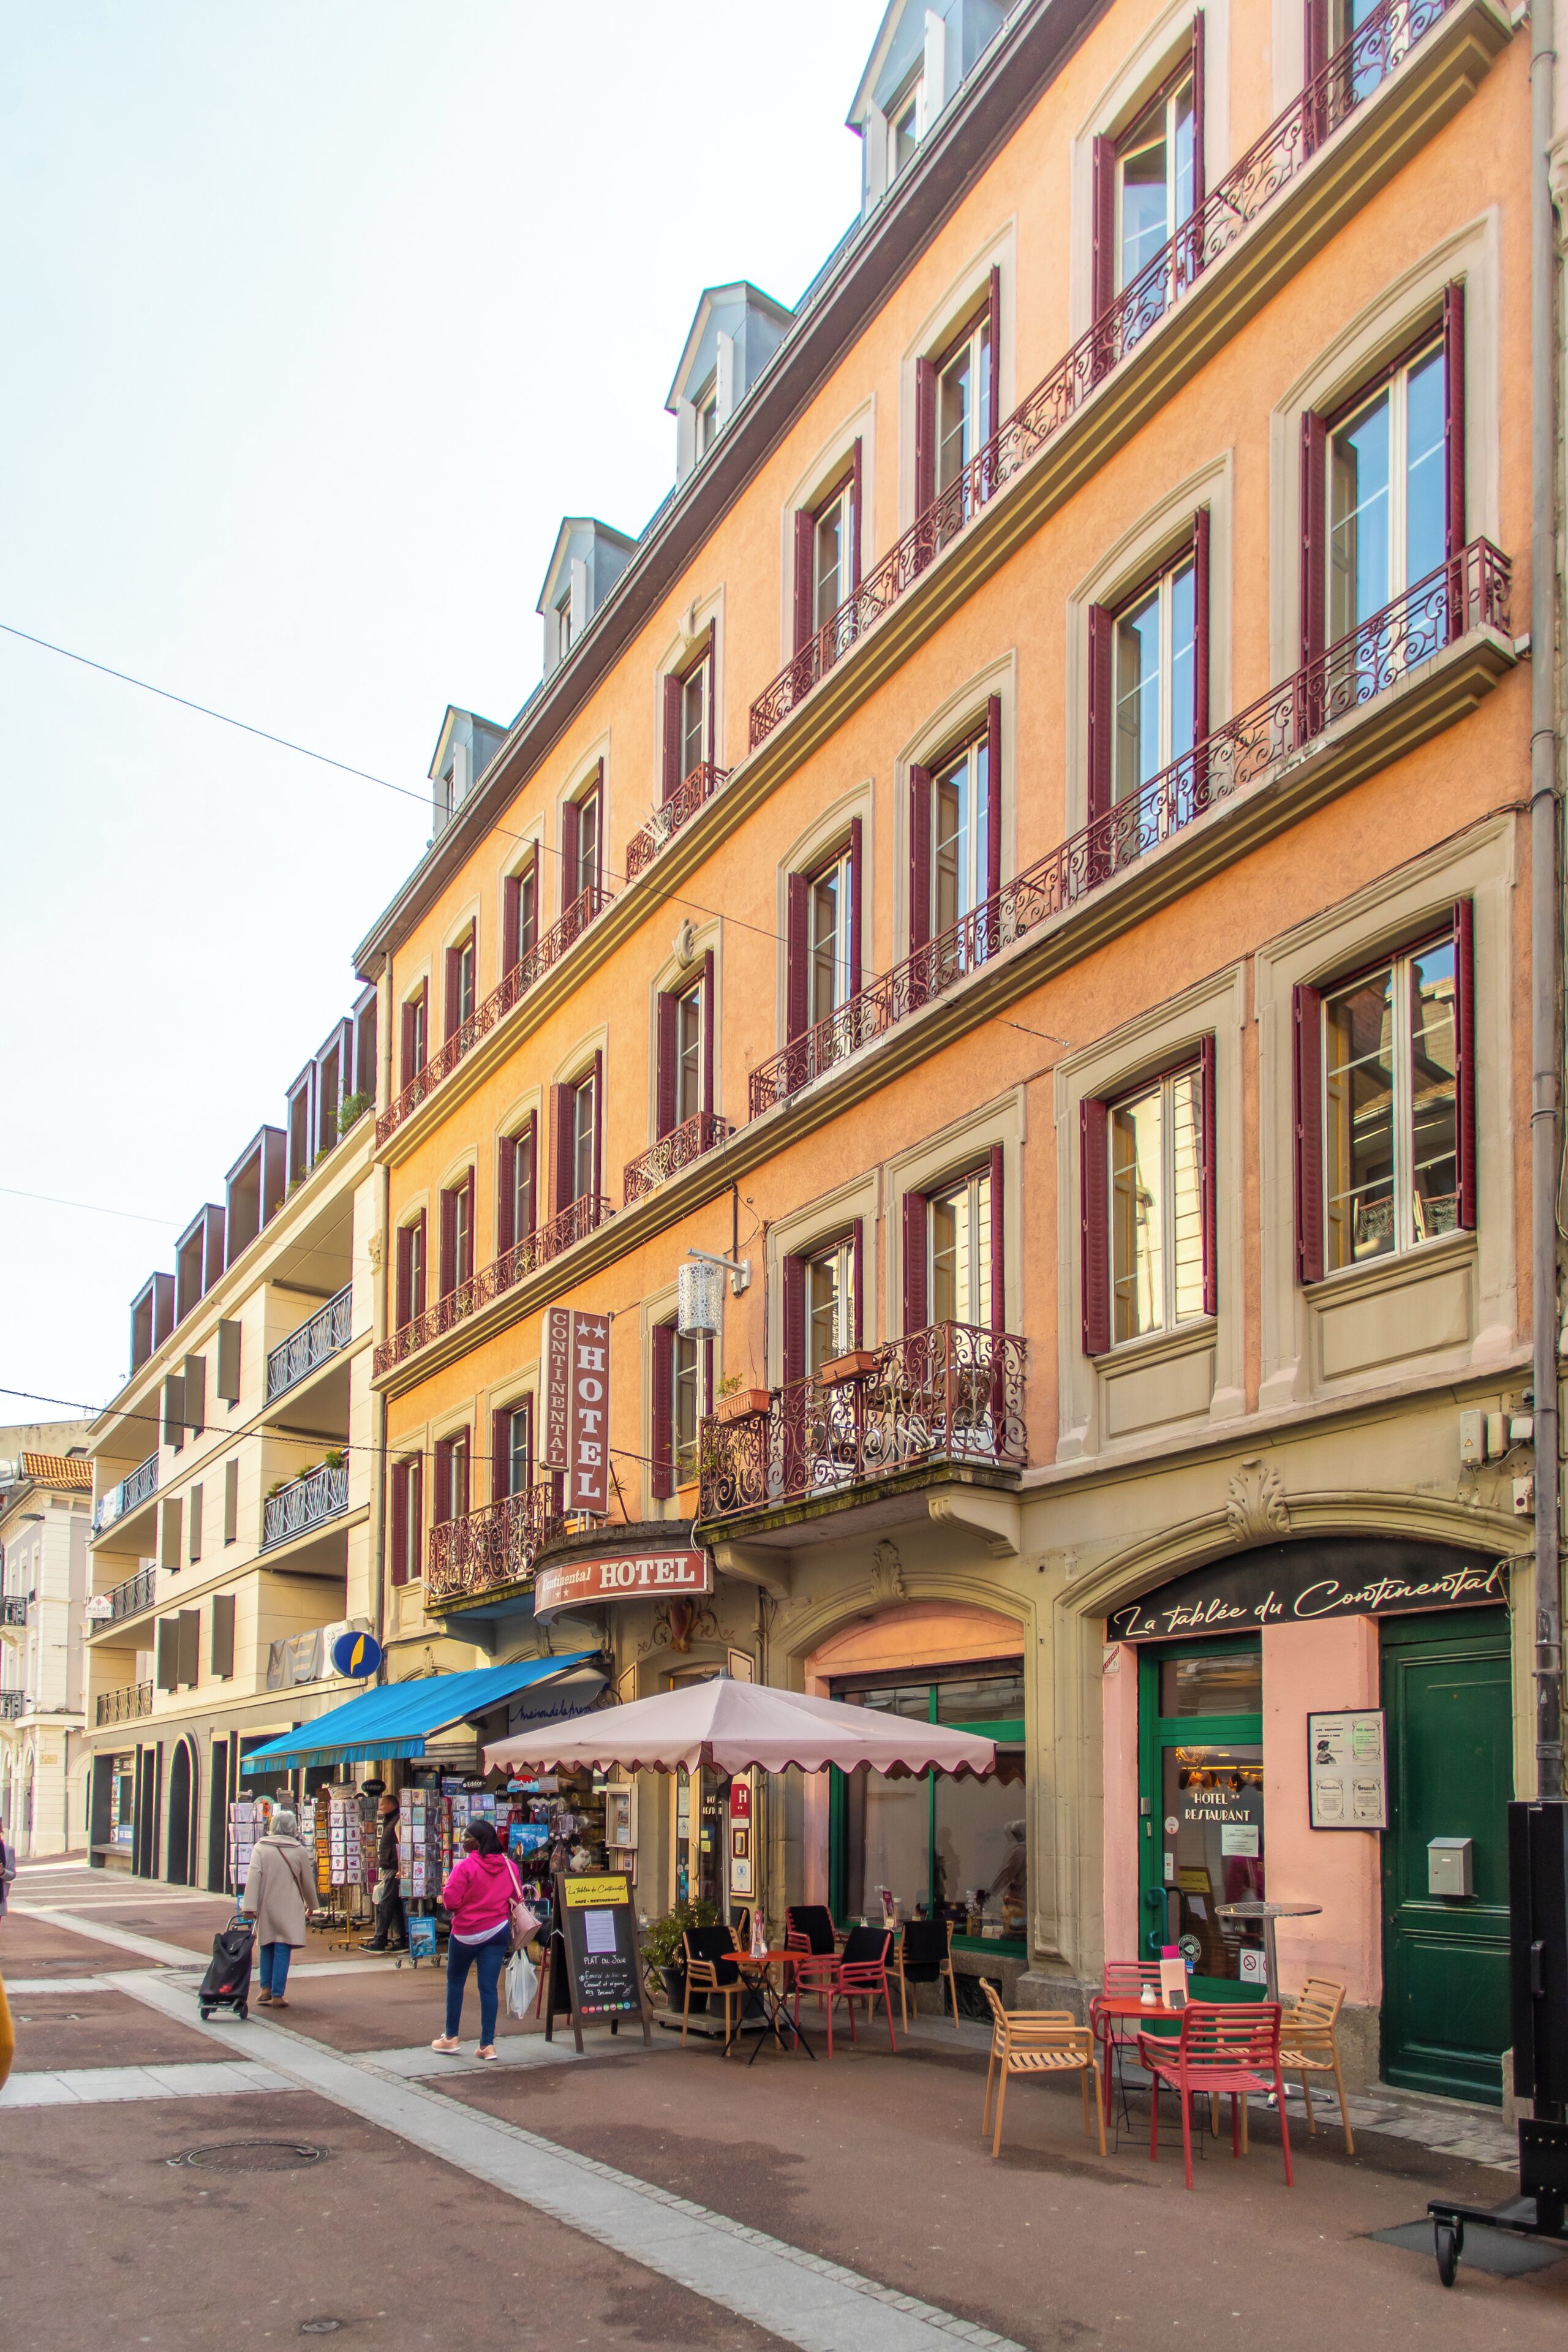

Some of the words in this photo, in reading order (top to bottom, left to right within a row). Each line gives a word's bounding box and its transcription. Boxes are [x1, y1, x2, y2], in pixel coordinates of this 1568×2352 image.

[549, 1313, 567, 1463] CONTINENTAL
[577, 1344, 606, 1498] HOTEL
[543, 1567, 592, 1591] Continental
[600, 1558, 695, 1589] HOTEL
[1114, 1606, 1156, 1636] La
[1162, 1598, 1247, 1632] tablée
[1254, 1591, 1283, 1623] du
[1294, 1565, 1499, 1617] Continental
[739, 1790, 747, 1803] H
[1194, 1793, 1229, 1804] HOTEL
[1185, 1809, 1251, 1822] RESTAURANT
[584, 1956, 600, 1965] PLAT
